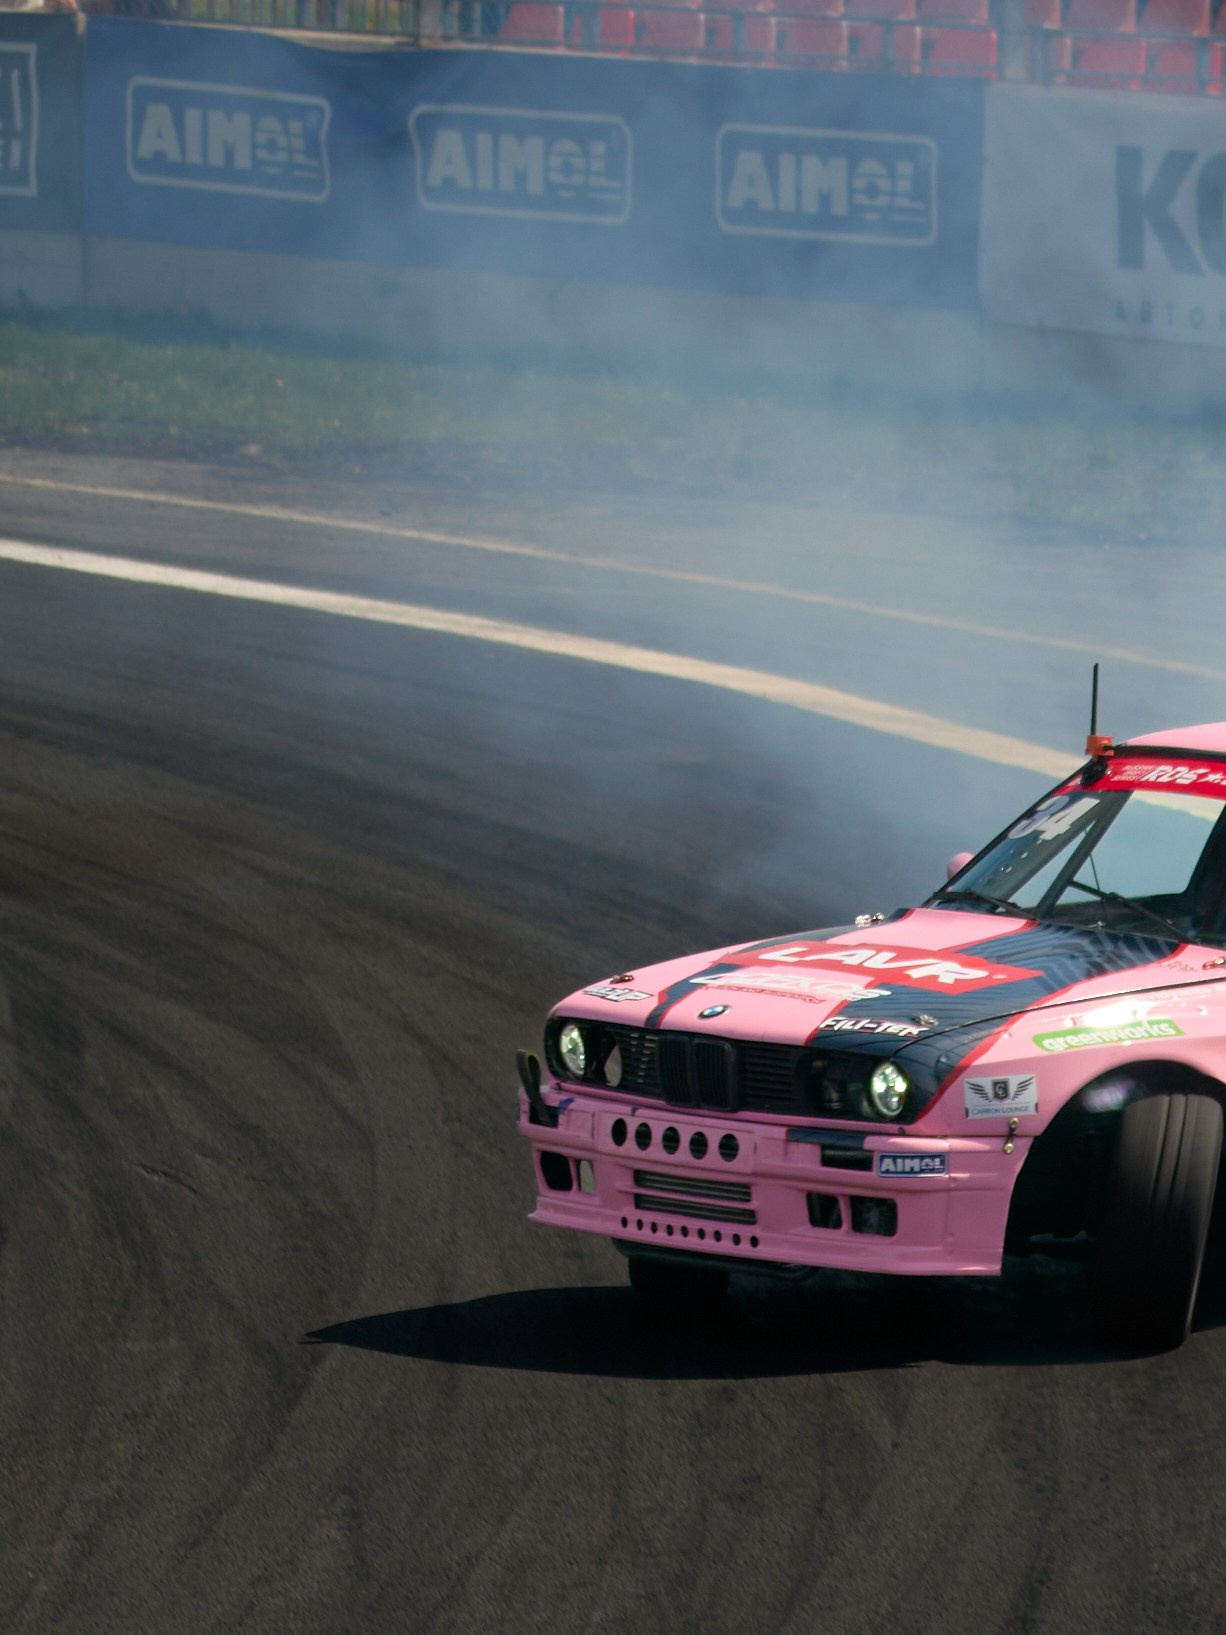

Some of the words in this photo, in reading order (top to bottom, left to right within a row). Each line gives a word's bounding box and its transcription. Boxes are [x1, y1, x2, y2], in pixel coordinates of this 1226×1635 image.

[136, 102, 321, 178] AIMOL
[427, 129, 622, 199] AIMOL
[725, 151, 928, 222] AIMOL
[1141, 765, 1210, 785] RDS
[757, 946, 989, 985] LAVR
[1041, 1021, 1178, 1052] greenworks
[880, 1157, 945, 1173] AIMOL
